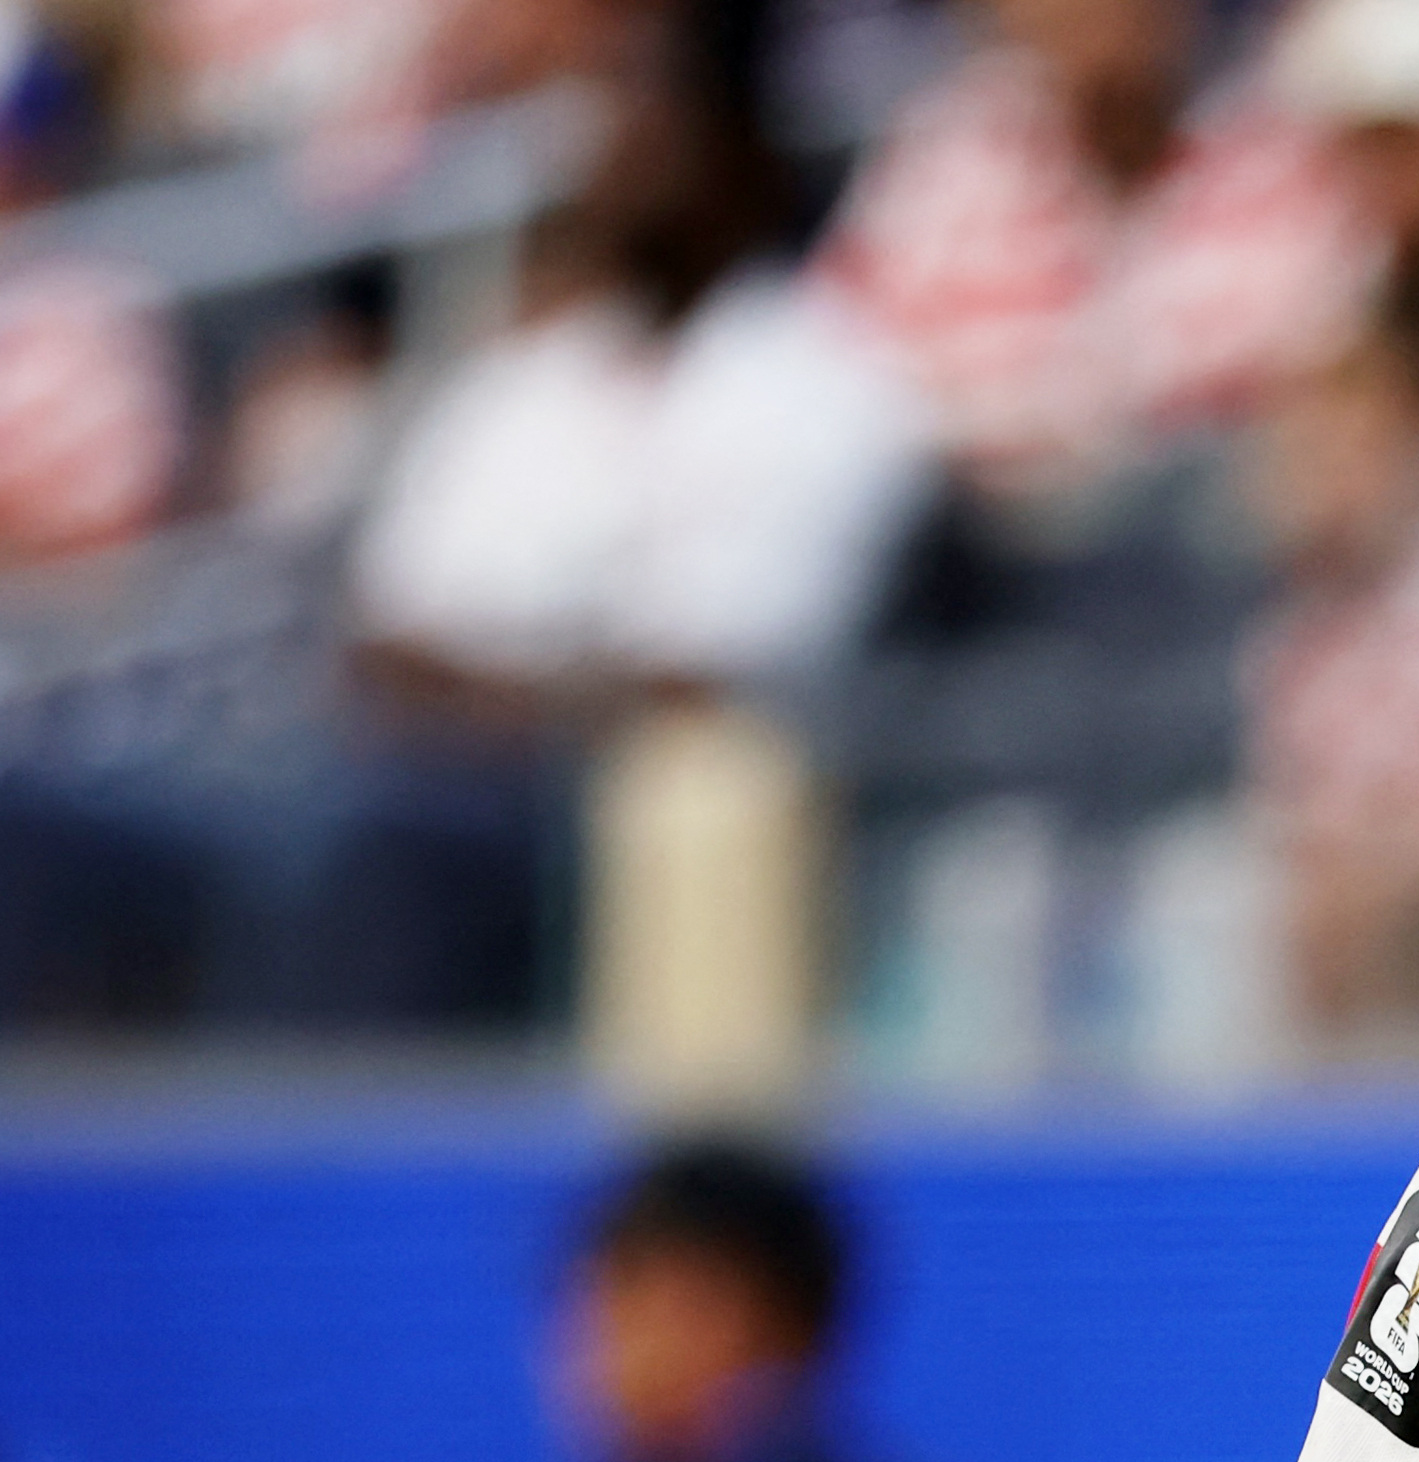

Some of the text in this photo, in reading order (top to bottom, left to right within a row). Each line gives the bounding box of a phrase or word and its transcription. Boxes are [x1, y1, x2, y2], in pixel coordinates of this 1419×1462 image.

[1355, 1341, 1409, 1395] WORLD CUP
[1387, 1328, 1405, 1355] FIFA
[1341, 1356, 1404, 1416] 2026
